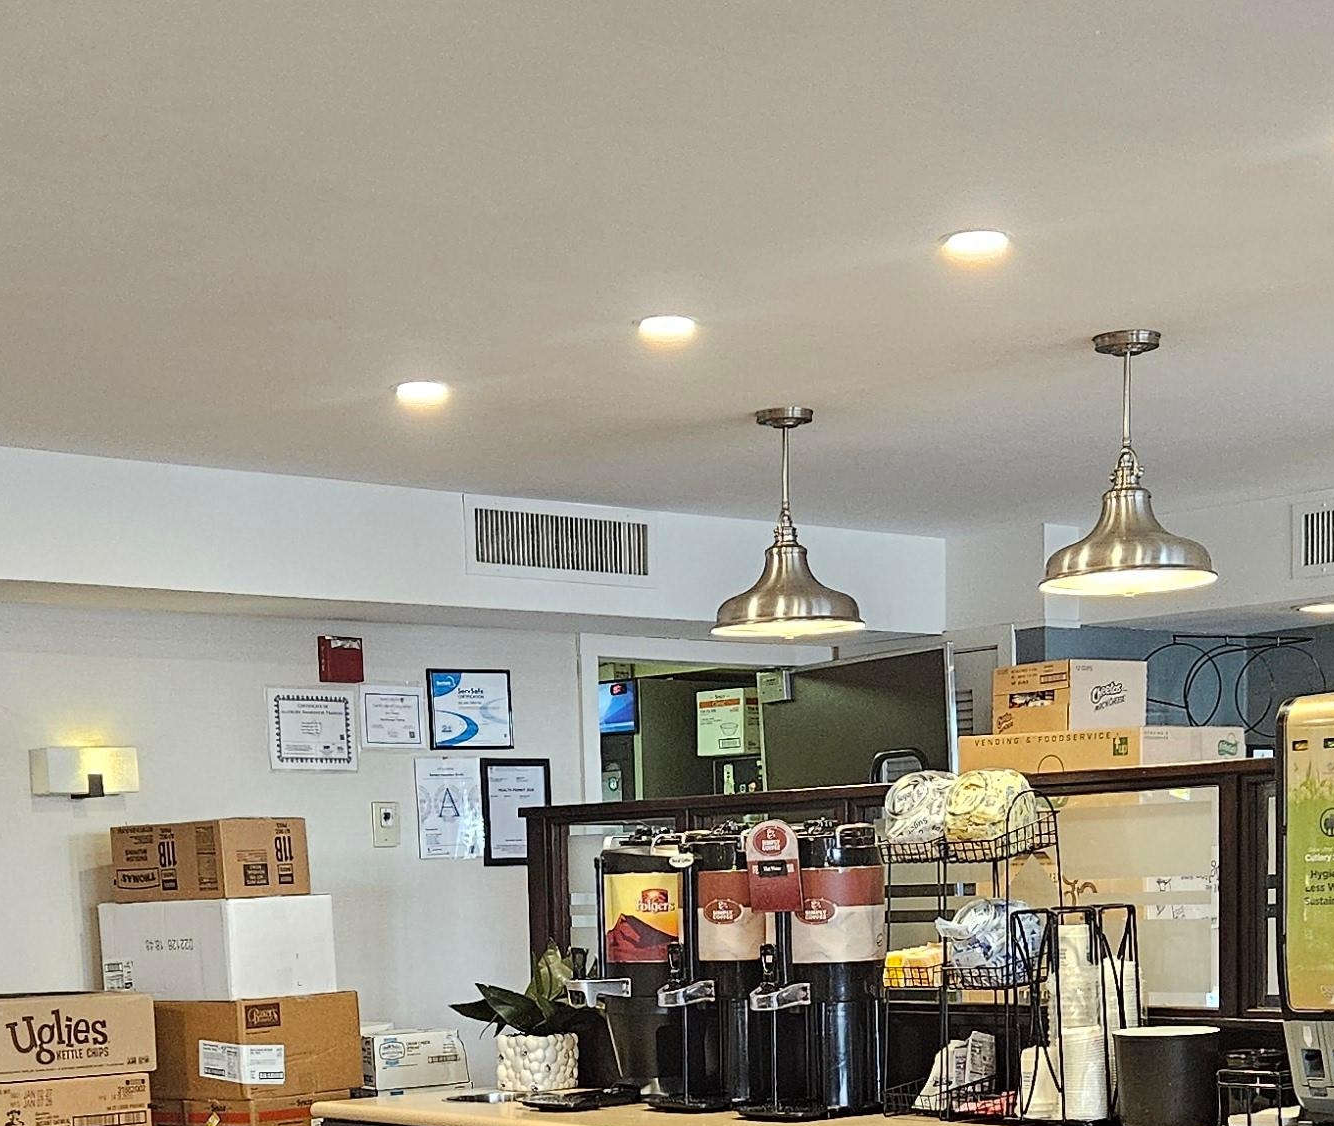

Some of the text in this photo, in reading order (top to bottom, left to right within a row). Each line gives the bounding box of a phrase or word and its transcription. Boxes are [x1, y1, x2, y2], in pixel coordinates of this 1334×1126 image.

[1090, 681, 1123, 704] Cheetos
[974, 737, 1019, 747] VENDING
[1038, 732, 1111, 743] FOODSERVICE
[438, 787, 460, 817] A
[158, 841, 177, 867] 11B
[275, 836, 294, 862] 11B
[635, 898, 675, 912] Folgers
[6, 1009, 108, 1065] Uglies
[56, 1047, 109, 1060] KETTLE CHIPS
